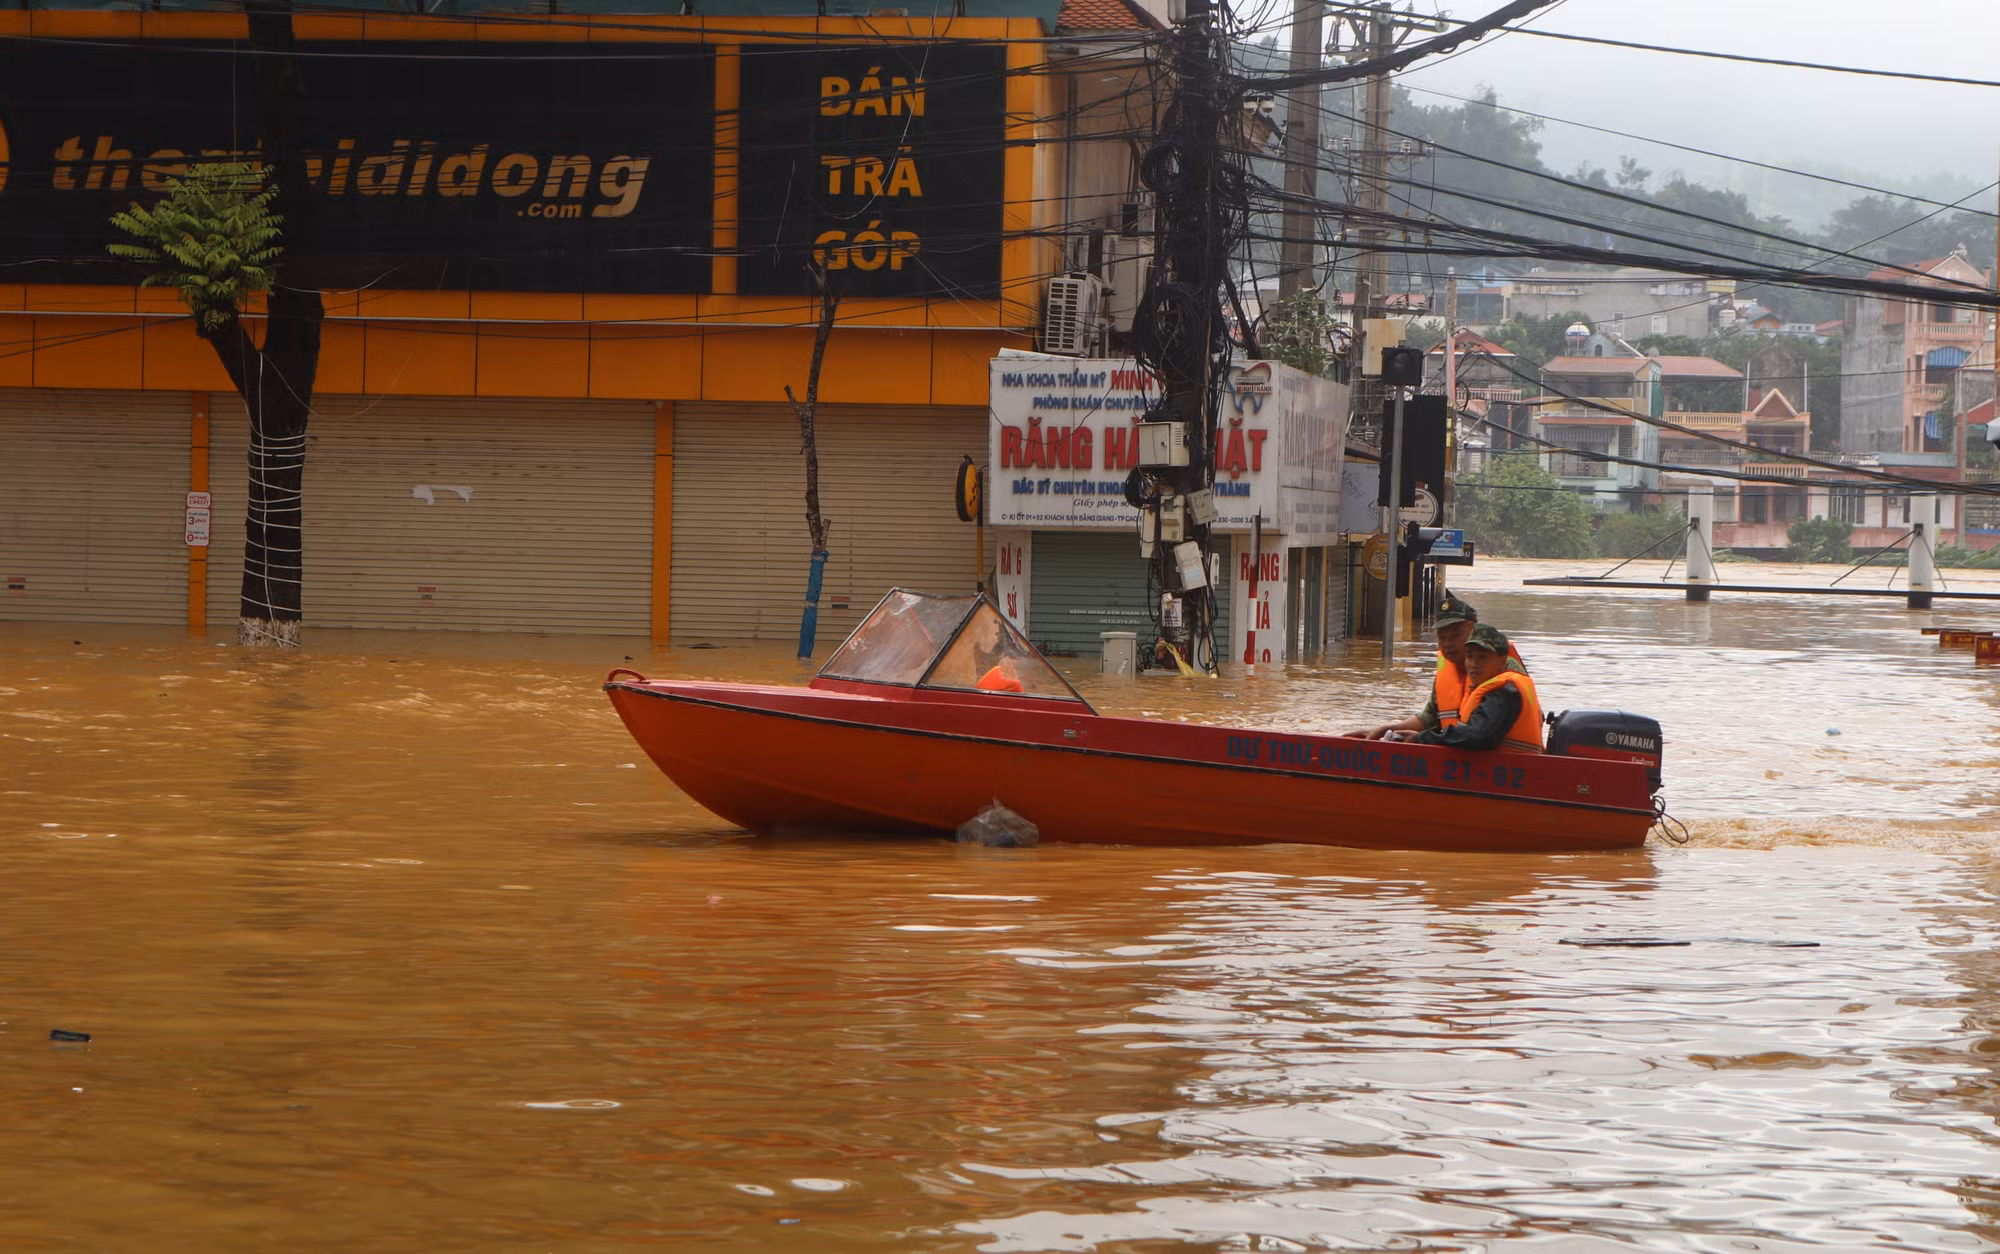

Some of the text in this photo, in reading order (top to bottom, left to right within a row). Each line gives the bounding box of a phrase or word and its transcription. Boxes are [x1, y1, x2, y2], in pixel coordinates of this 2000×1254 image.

[820, 66, 926, 117] BÁN
[821, 146, 922, 198] TRẢ
[517, 202, 582, 219] .com
[813, 220, 921, 271] GÓP
[1002, 373, 1024, 388] NHA
[1027, 373, 1057, 388] KHOA
[1091, 373, 1107, 389] MỸ
[1111, 370, 1153, 390] MINH
[1033, 394, 1070, 410] PHÒNG
[1071, 394, 1103, 410] KHÁM
[1105, 395, 1150, 411] CHUYÊN
[1001, 417, 1093, 469] RĂNG
[1013, 477, 1034, 494] BÁC
[1037, 477, 1051, 495] SỸ
[1053, 480, 1096, 495] CHUYÊN
[1098, 482, 1126, 496] KHOA
[1073, 498, 1095, 508] Giấy
[1097, 499, 1119, 508] phép
[1044, 513, 1064, 521] KHÁCH
[1241, 553, 1280, 581] RNG
[1618, 734, 1655, 750] YAMAHA
[1227, 735, 1262, 764] DỰ
[1319, 743, 1381, 773] QUỐC
[1390, 755, 1429, 778] GIA
